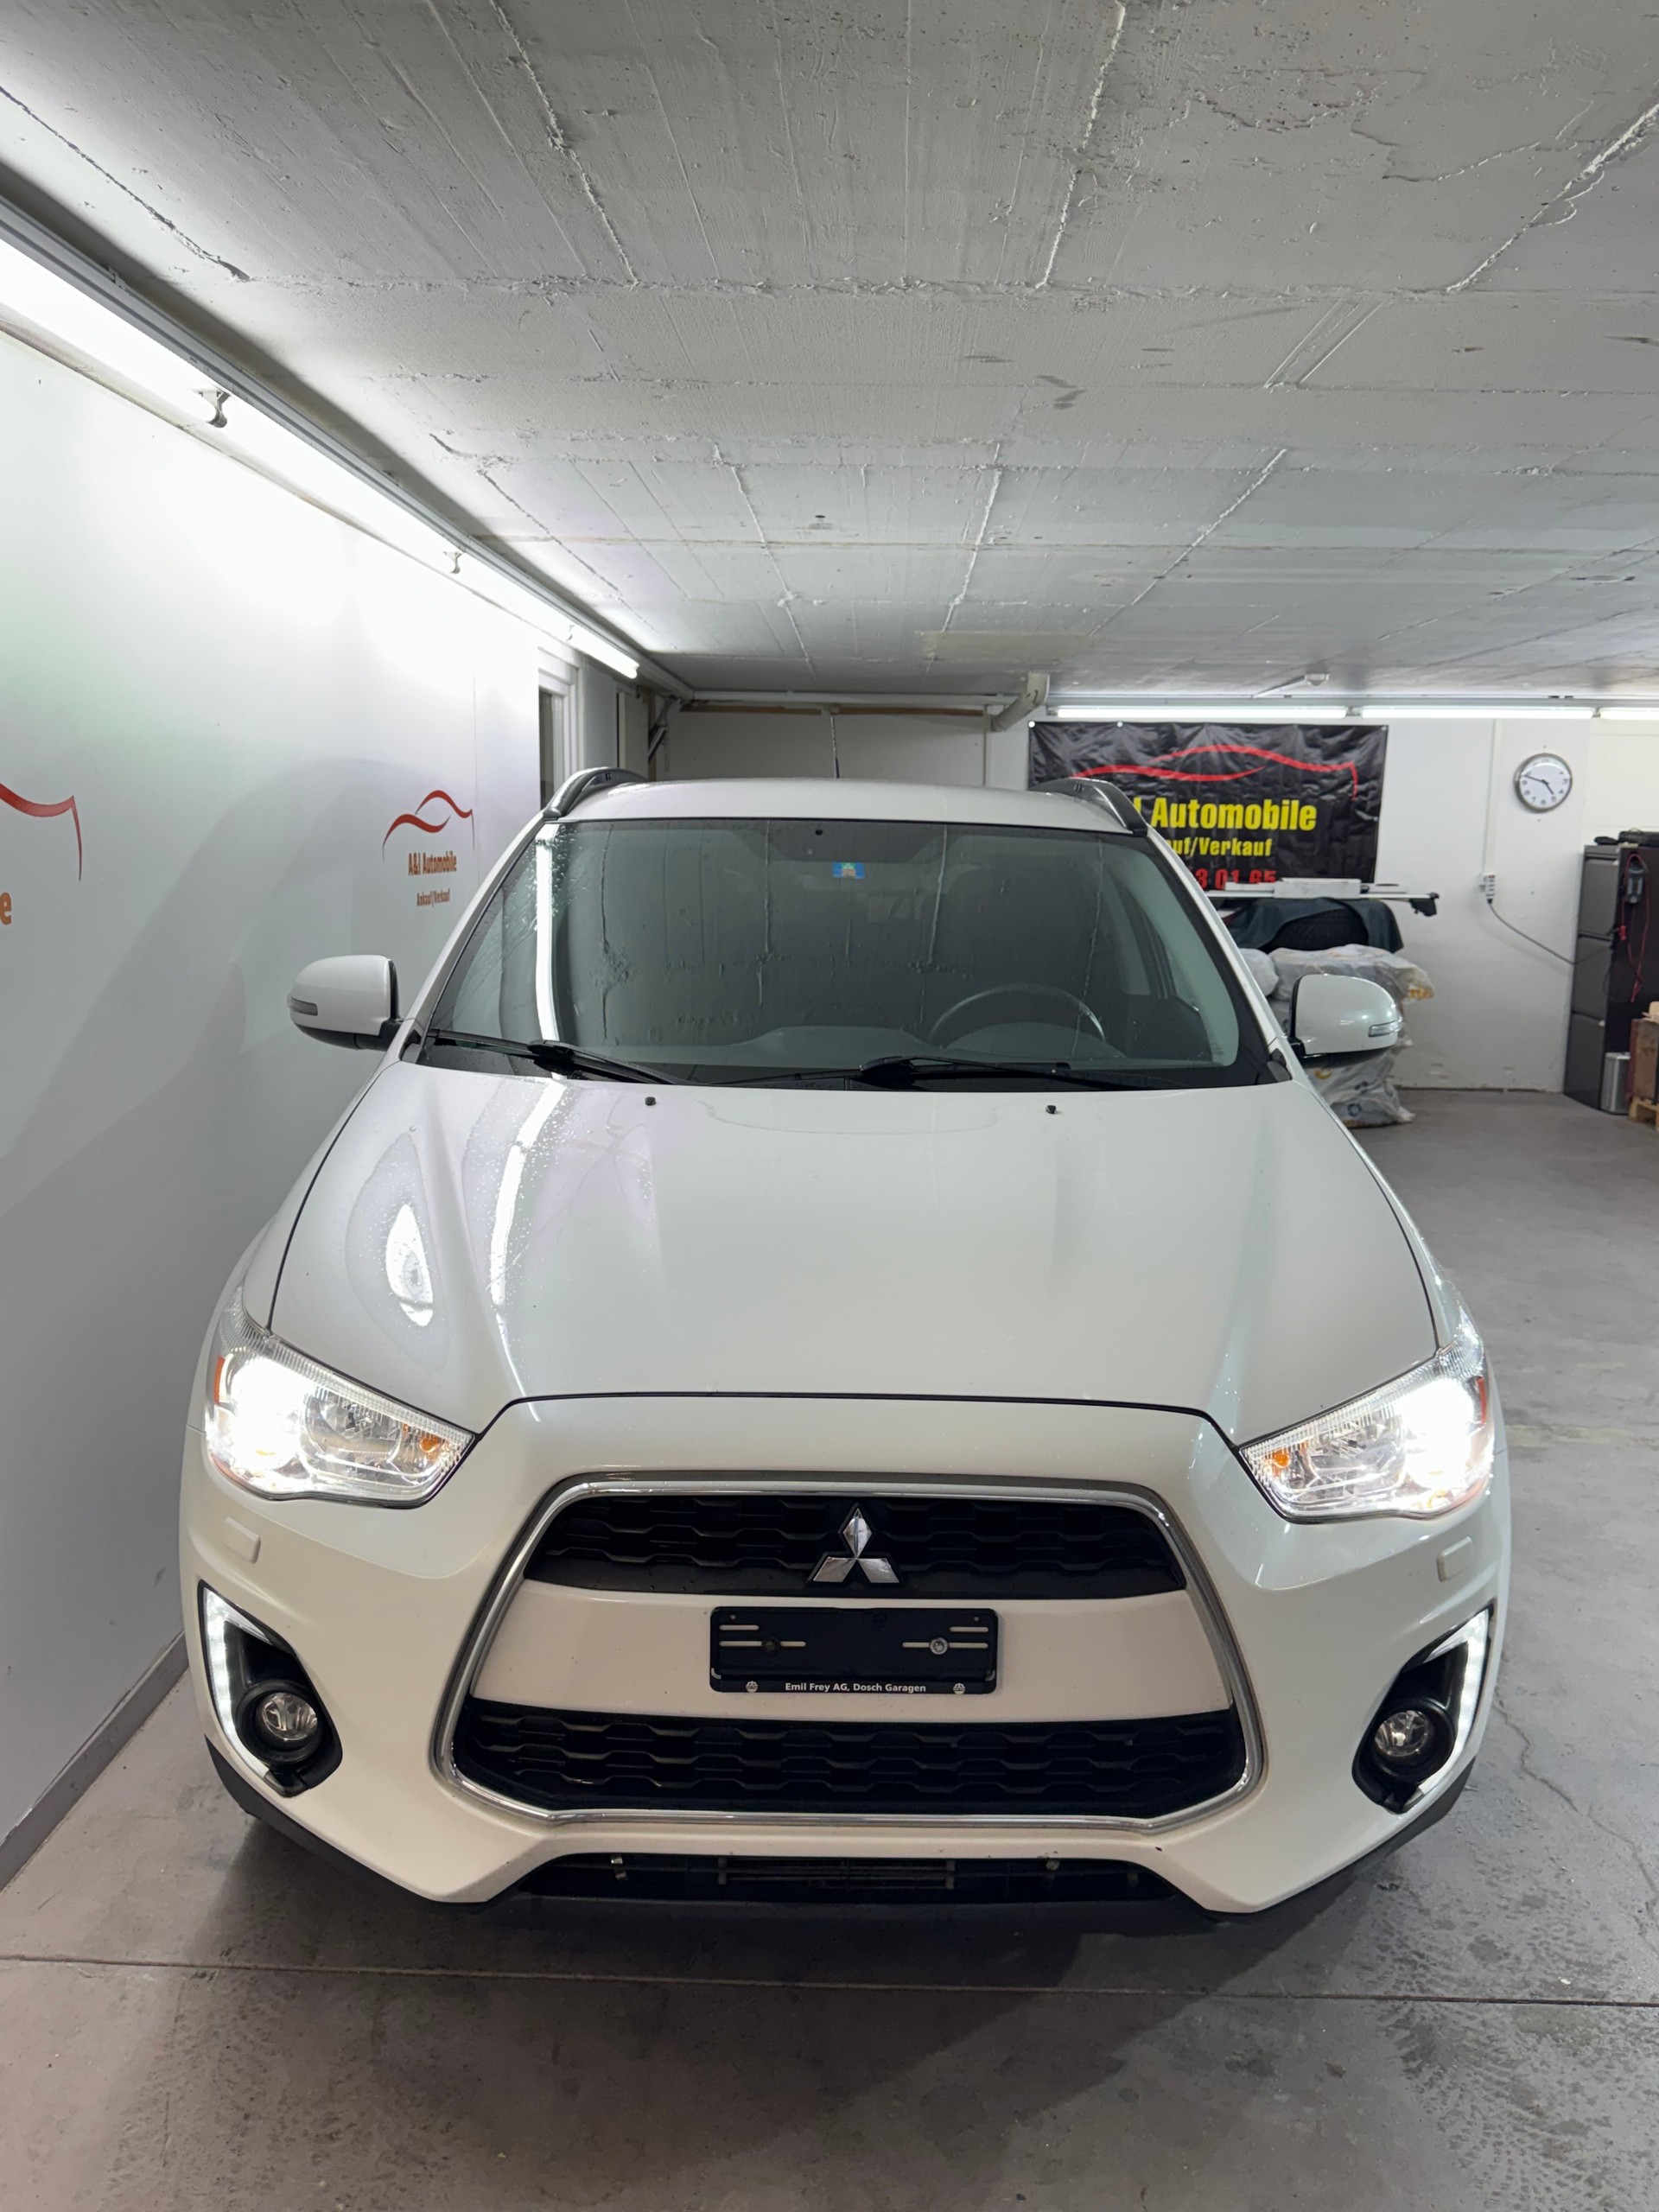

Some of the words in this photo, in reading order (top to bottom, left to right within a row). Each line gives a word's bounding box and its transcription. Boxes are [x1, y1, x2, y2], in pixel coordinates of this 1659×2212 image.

[1151, 798, 1318, 831] Automobile
[423, 850, 457, 874] Automobile
[785, 1682, 807, 1691] Emil
[809, 1682, 830, 1693] Frey
[832, 1682, 850, 1692] AG,
[885, 1683, 926, 1694] Garagen
